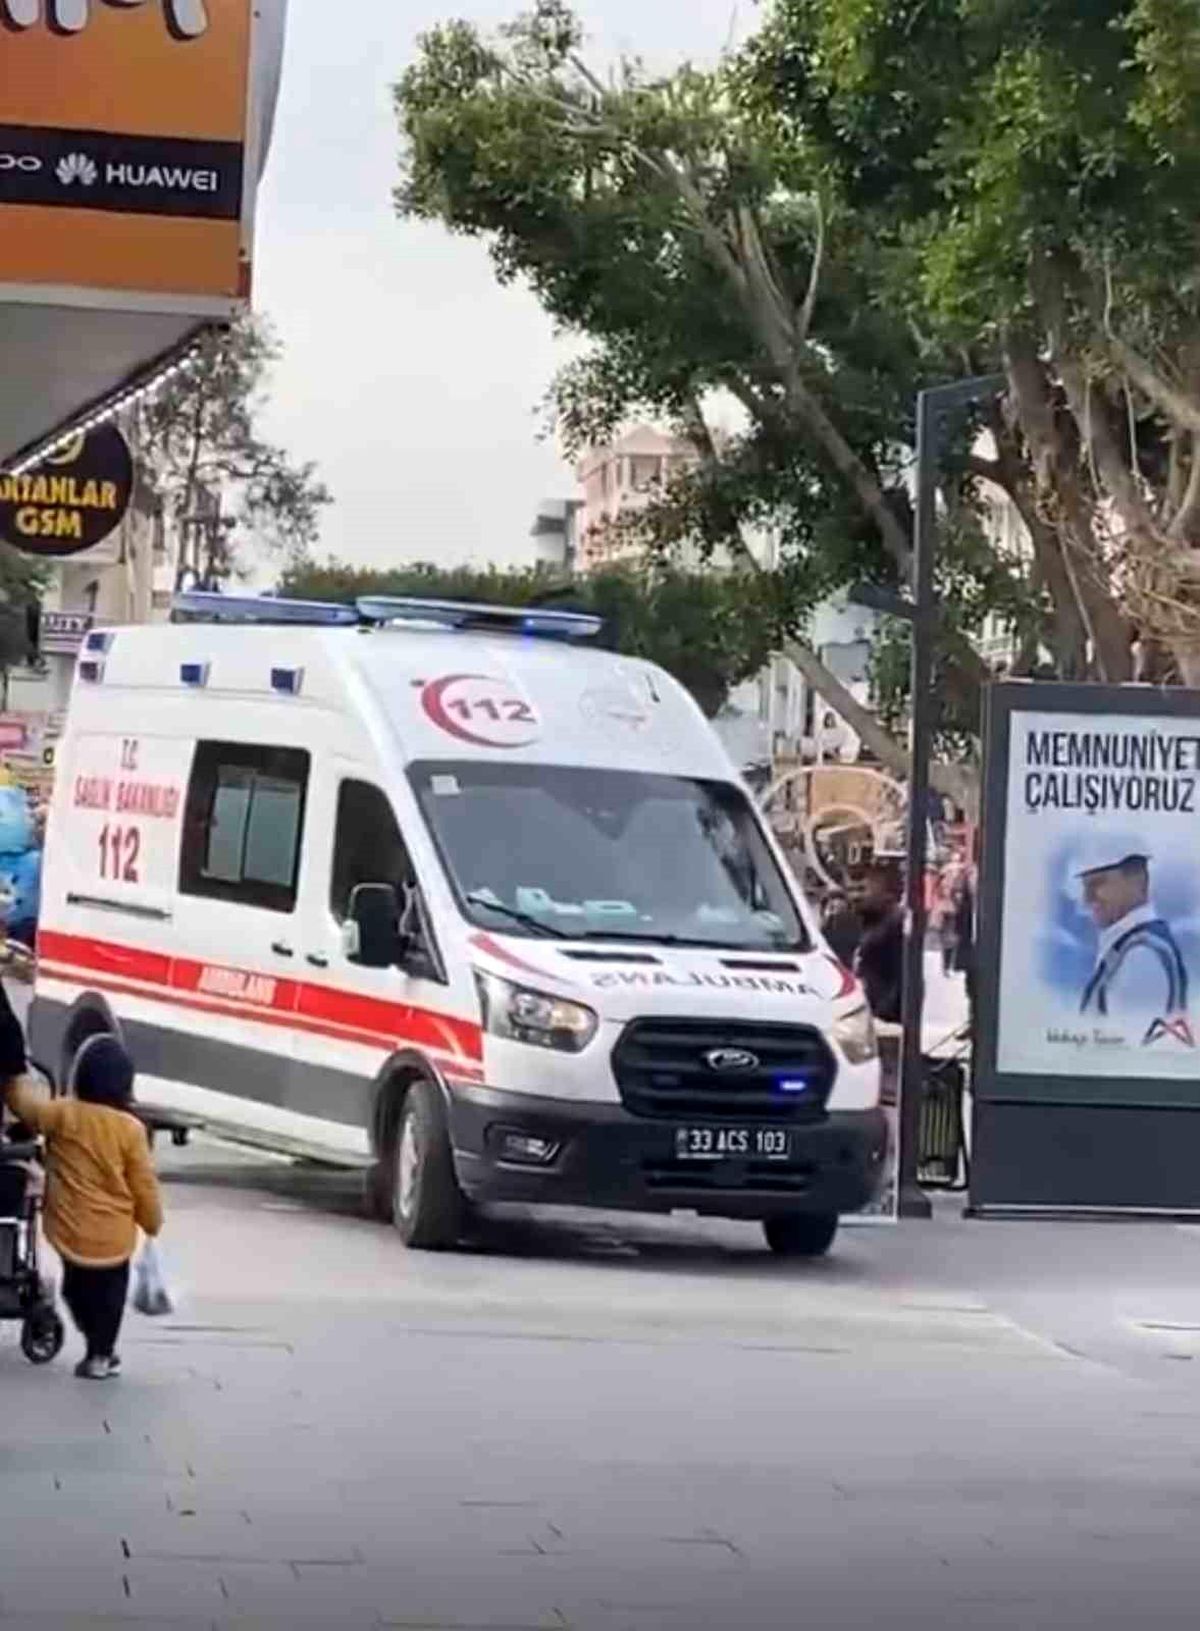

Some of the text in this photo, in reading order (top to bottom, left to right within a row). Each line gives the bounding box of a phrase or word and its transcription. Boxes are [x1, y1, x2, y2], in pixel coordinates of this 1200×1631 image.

[106, 163, 217, 191] HUAWEI
[16, 506, 82, 538] GSM
[447, 698, 537, 724] 112
[1024, 772, 1196, 815] ÇALIŞIYORUZ
[98, 822, 141, 883] 112
[690, 1129, 786, 1153] 33 ACS 103
